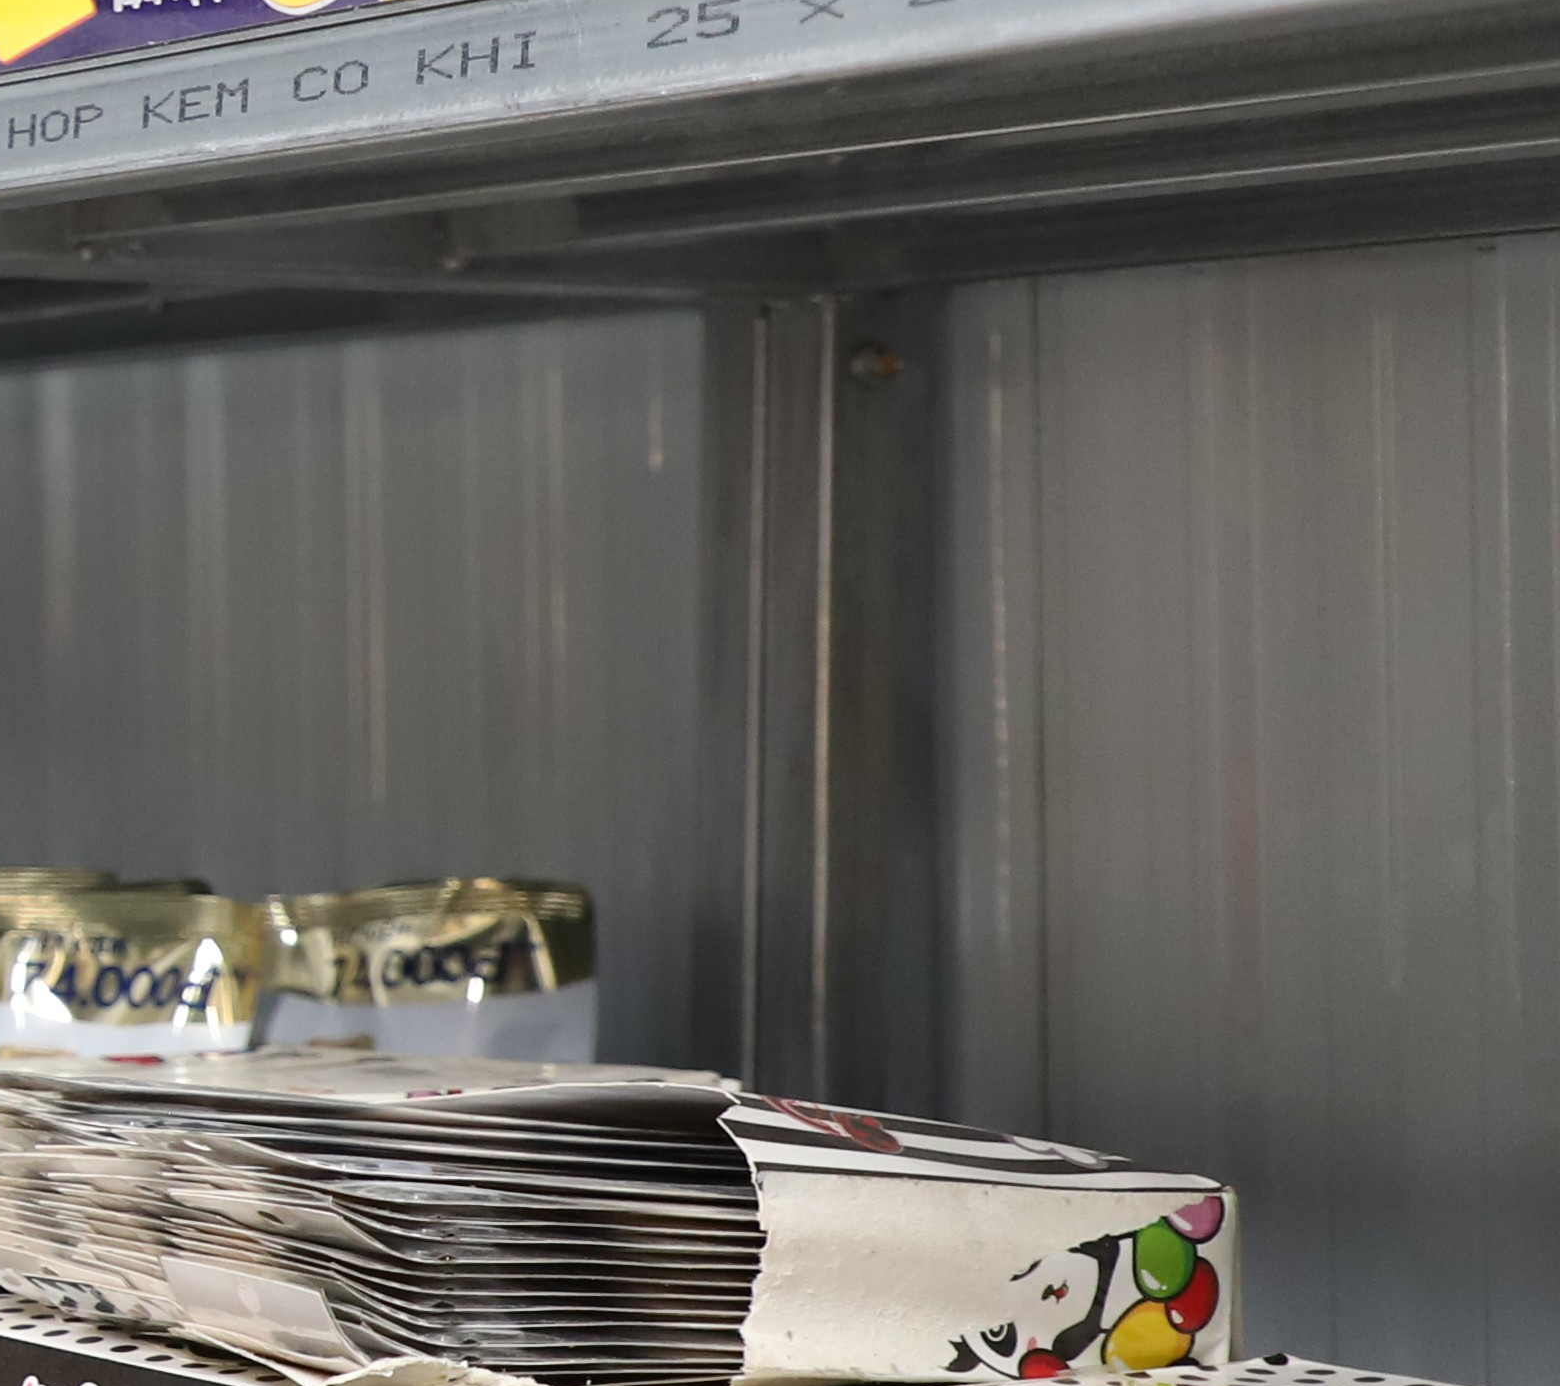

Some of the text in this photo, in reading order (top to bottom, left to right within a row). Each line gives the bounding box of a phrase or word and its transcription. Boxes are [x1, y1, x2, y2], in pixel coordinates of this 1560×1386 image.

[8, 104, 104, 150] HOP
[141, 78, 250, 129] KEM
[293, 59, 370, 103] CO
[416, 30, 538, 87] KHI
